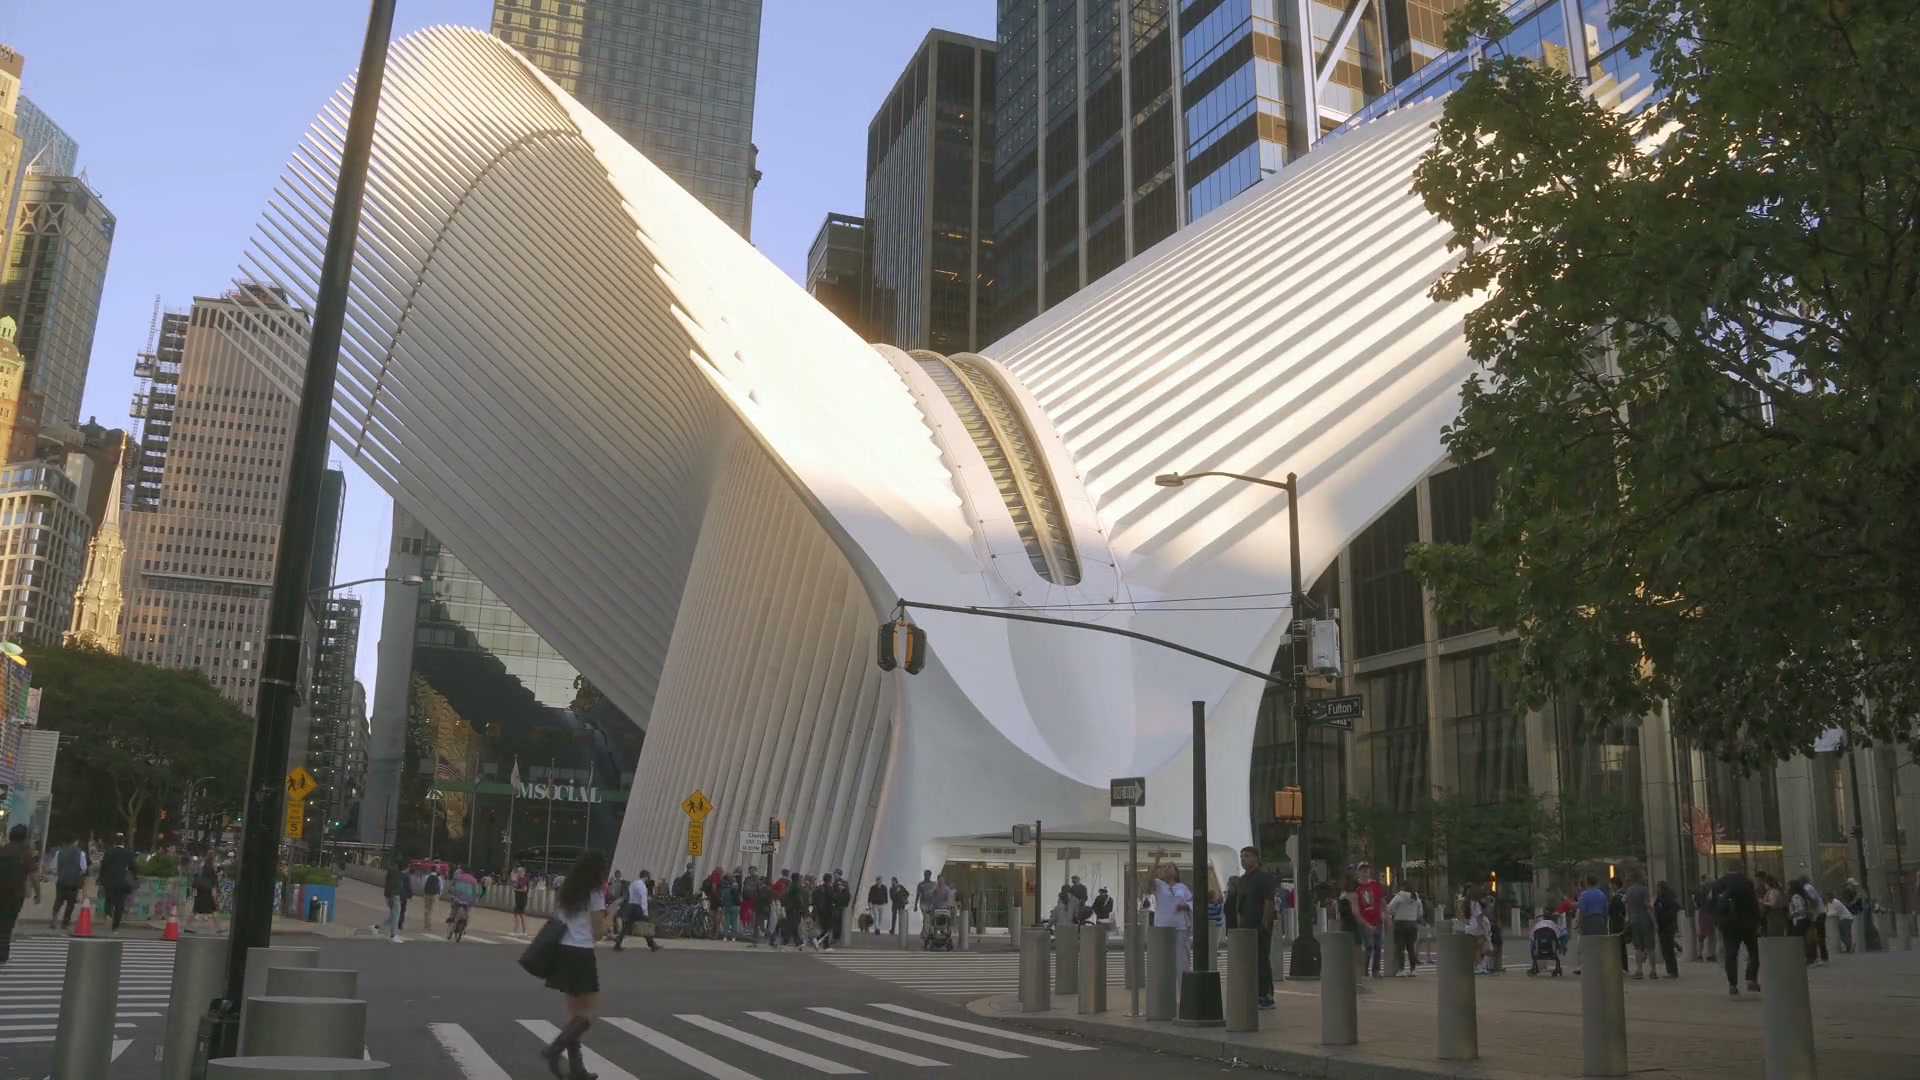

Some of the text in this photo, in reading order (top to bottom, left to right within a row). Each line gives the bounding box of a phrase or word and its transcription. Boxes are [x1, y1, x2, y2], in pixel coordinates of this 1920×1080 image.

[1328, 703, 1352, 714] Fulton
[1113, 787, 1137, 799] ONE WAY
[290, 823, 297, 832] 5
[692, 842, 698, 850] 5
